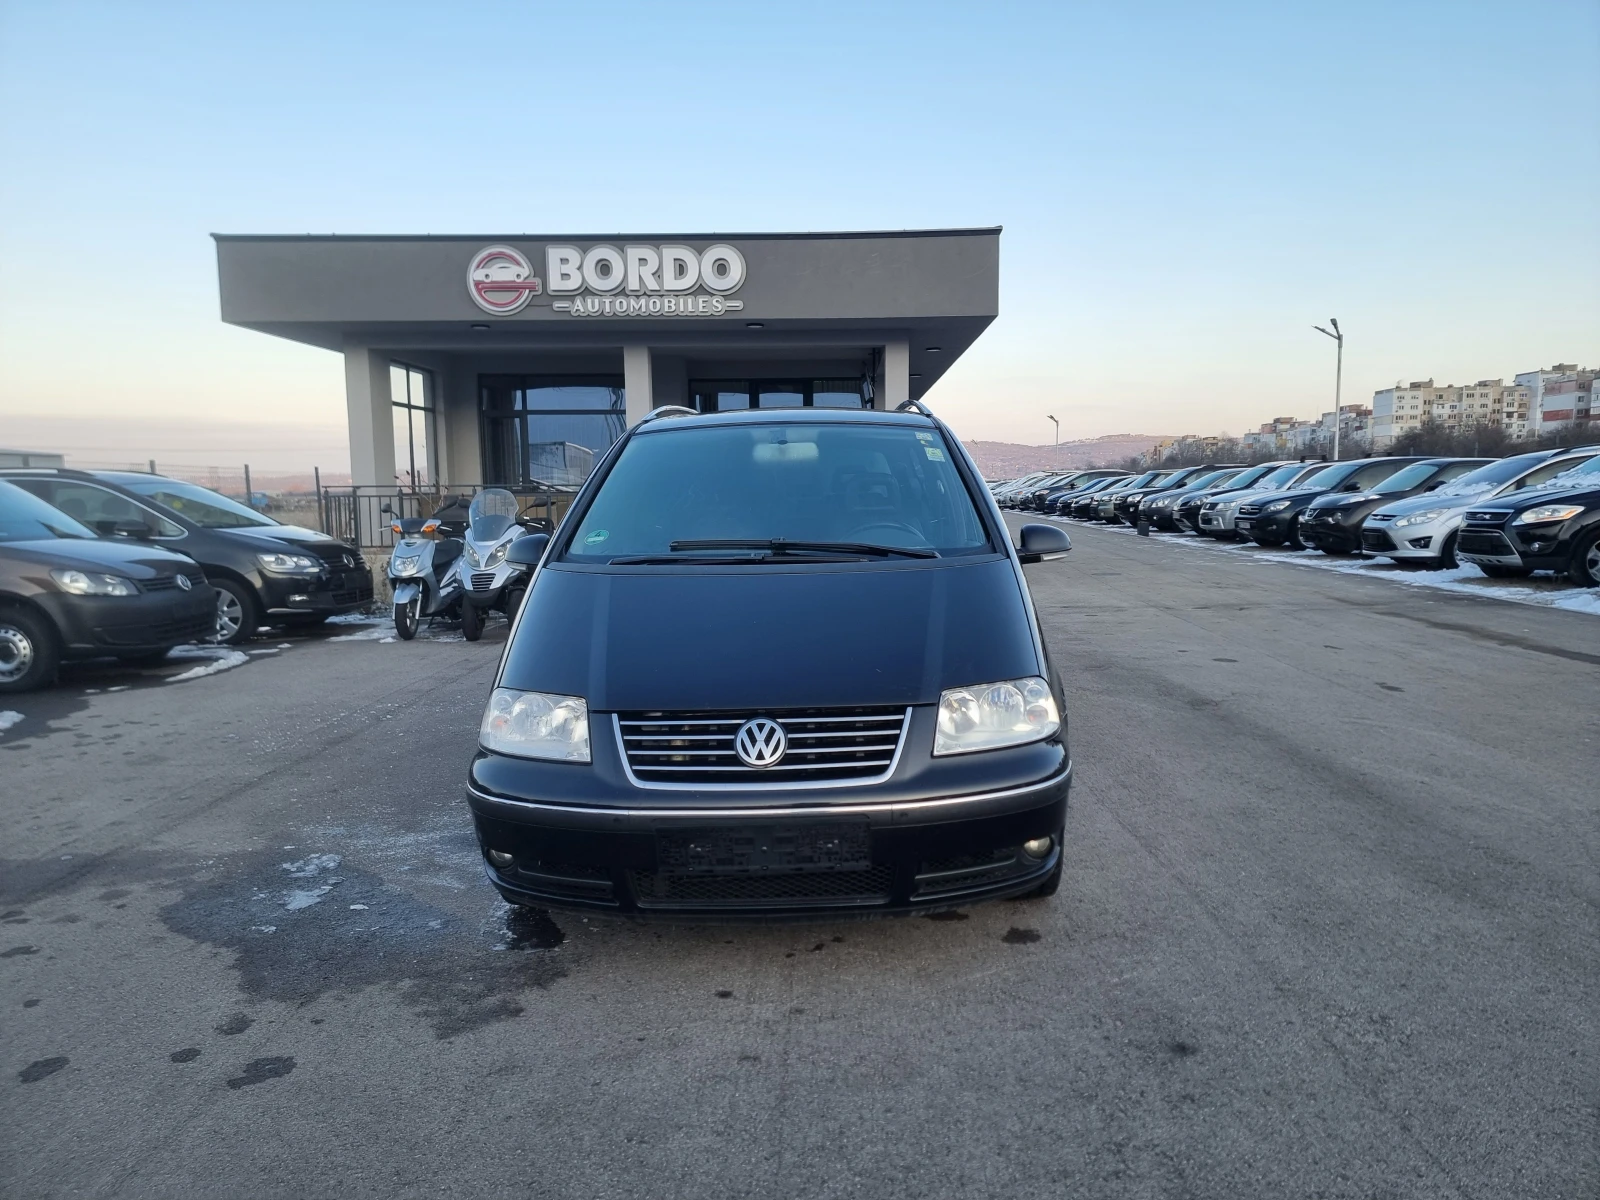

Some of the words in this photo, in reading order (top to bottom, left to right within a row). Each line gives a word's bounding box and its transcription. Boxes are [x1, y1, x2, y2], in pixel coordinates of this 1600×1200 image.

[546, 247, 743, 292] BORDO
[572, 297, 724, 314] AUTOMOBILES
[736, 718, 786, 767] VW
